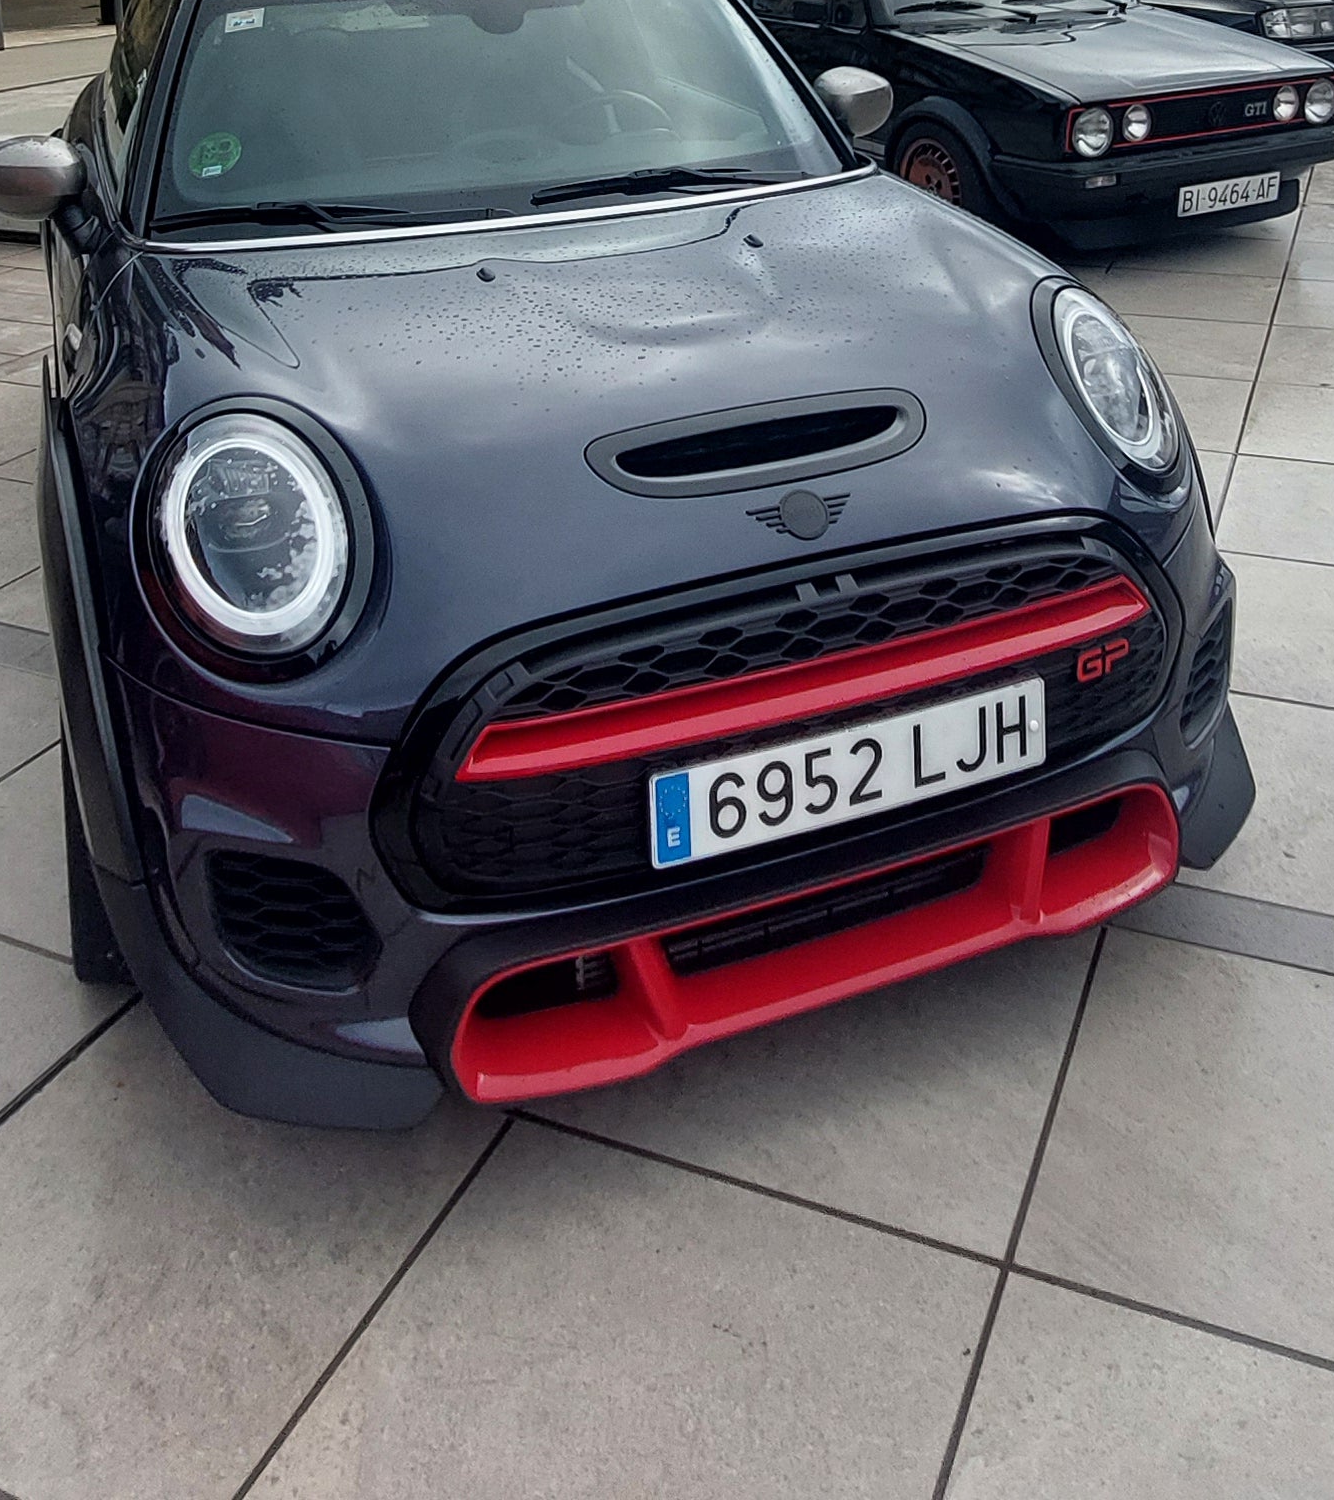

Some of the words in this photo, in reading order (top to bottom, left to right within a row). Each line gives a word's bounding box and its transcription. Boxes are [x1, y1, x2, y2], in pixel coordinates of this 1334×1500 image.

[1244, 101, 1267, 117] GTI
[1182, 176, 1278, 214] BI-9464-AF
[1077, 638, 1129, 683] GP
[708, 737, 883, 839] 6952
[912, 694, 1028, 789] LJH
[666, 825, 681, 848] E
